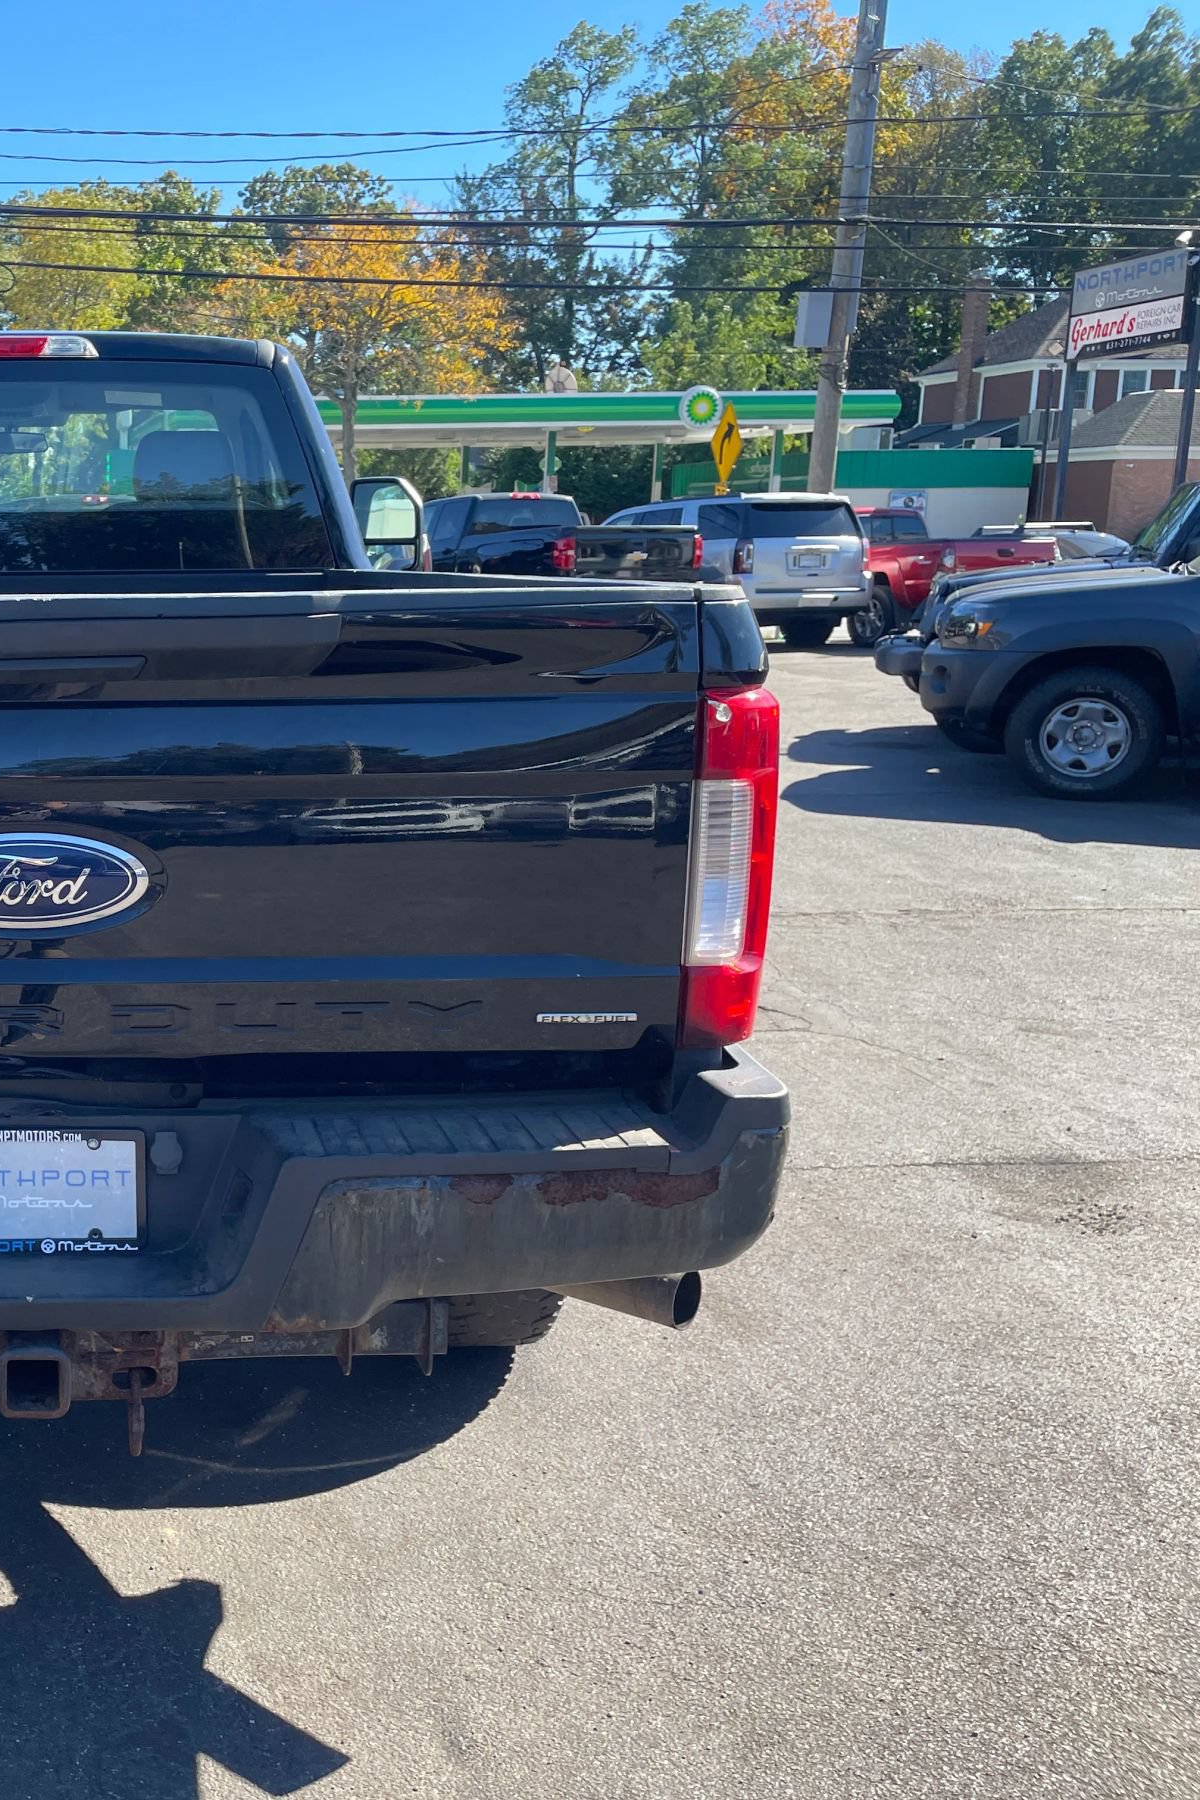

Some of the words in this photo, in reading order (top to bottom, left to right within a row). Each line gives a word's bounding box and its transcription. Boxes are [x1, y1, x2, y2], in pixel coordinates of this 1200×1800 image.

[1075, 252, 1188, 293] NORTHPORT
[1106, 285, 1164, 302] Motors
[1137, 306, 1166, 320] FOREIGN
[1167, 303, 1182, 314] CAR
[1071, 311, 1136, 351] Gerhard's
[1136, 318, 1162, 330] REPAIRS
[1106, 335, 1151, 351] 631-271-7744
[542, 1015, 580, 1023] FLEX
[58, 1240, 139, 1251] Motors
